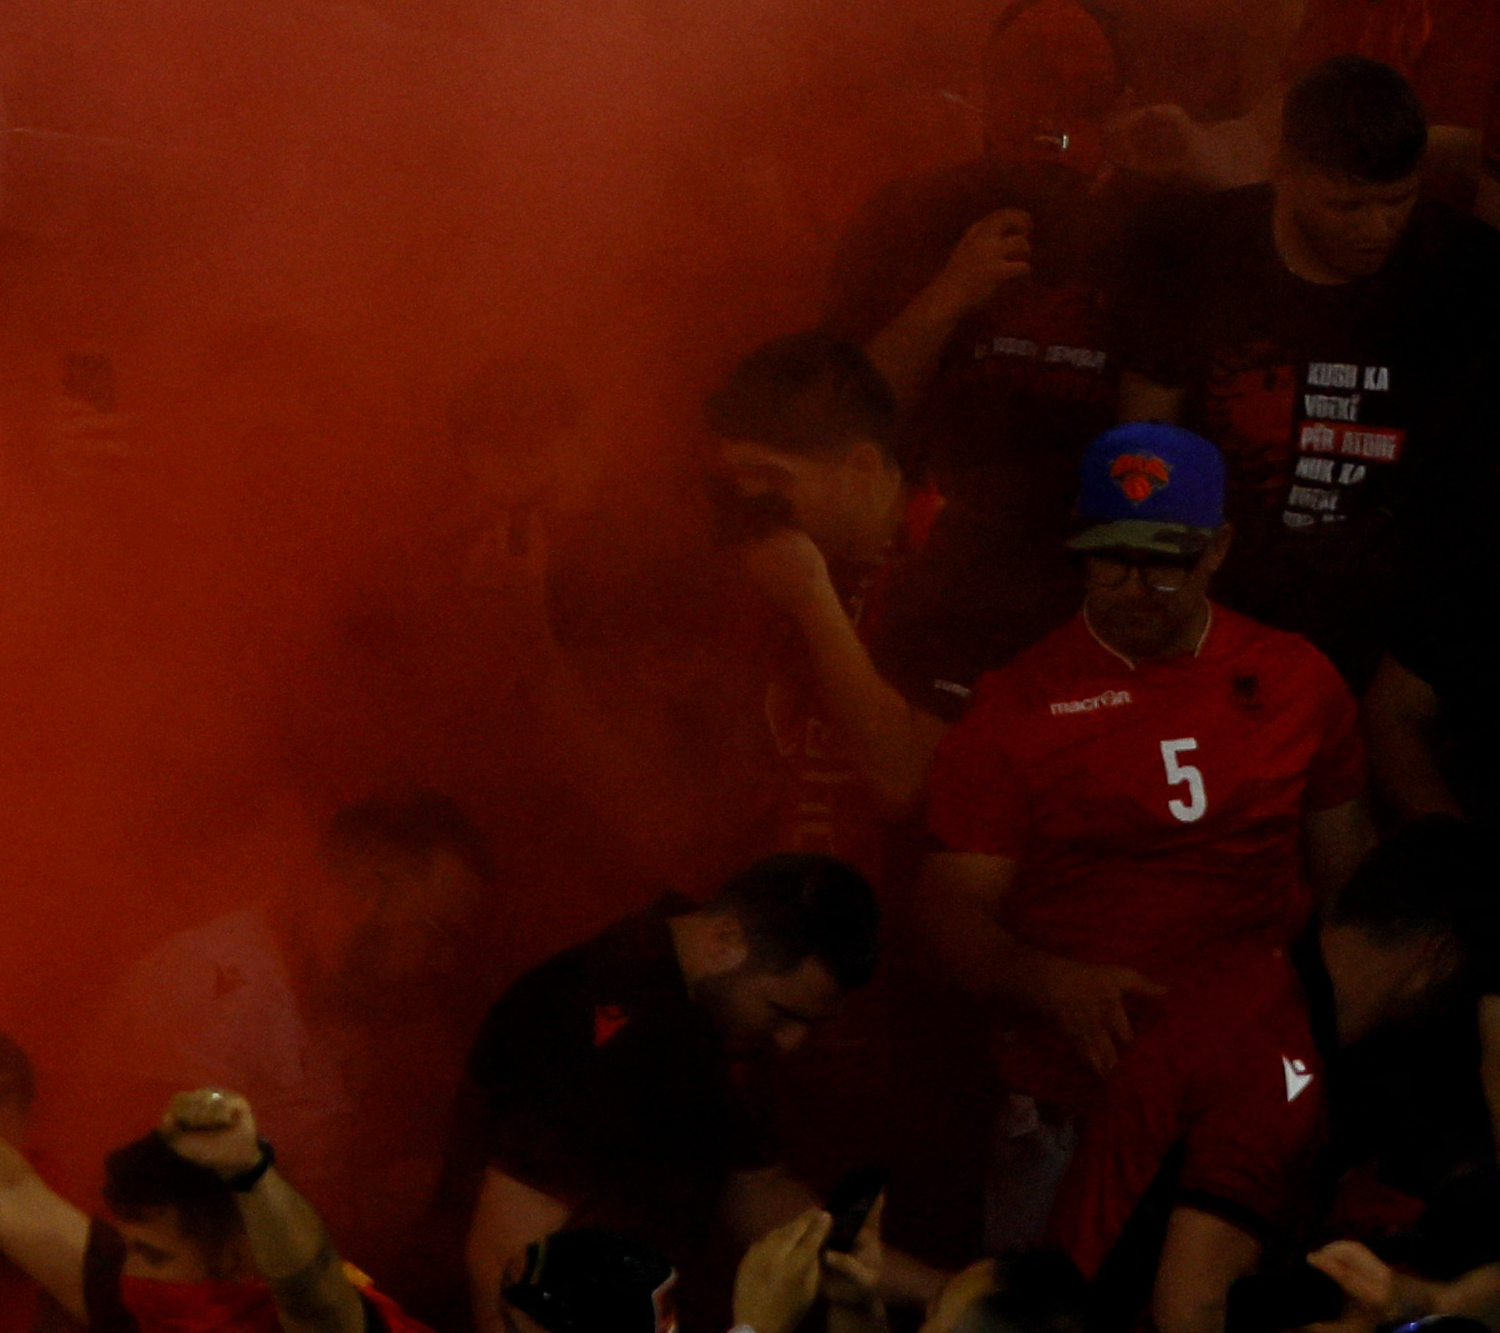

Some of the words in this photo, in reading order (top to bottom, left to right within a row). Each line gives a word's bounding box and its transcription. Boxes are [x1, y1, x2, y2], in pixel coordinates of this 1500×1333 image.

[1363, 366, 1390, 391] KA
[1049, 688, 1133, 715] macron
[1160, 736, 1208, 824] 5
